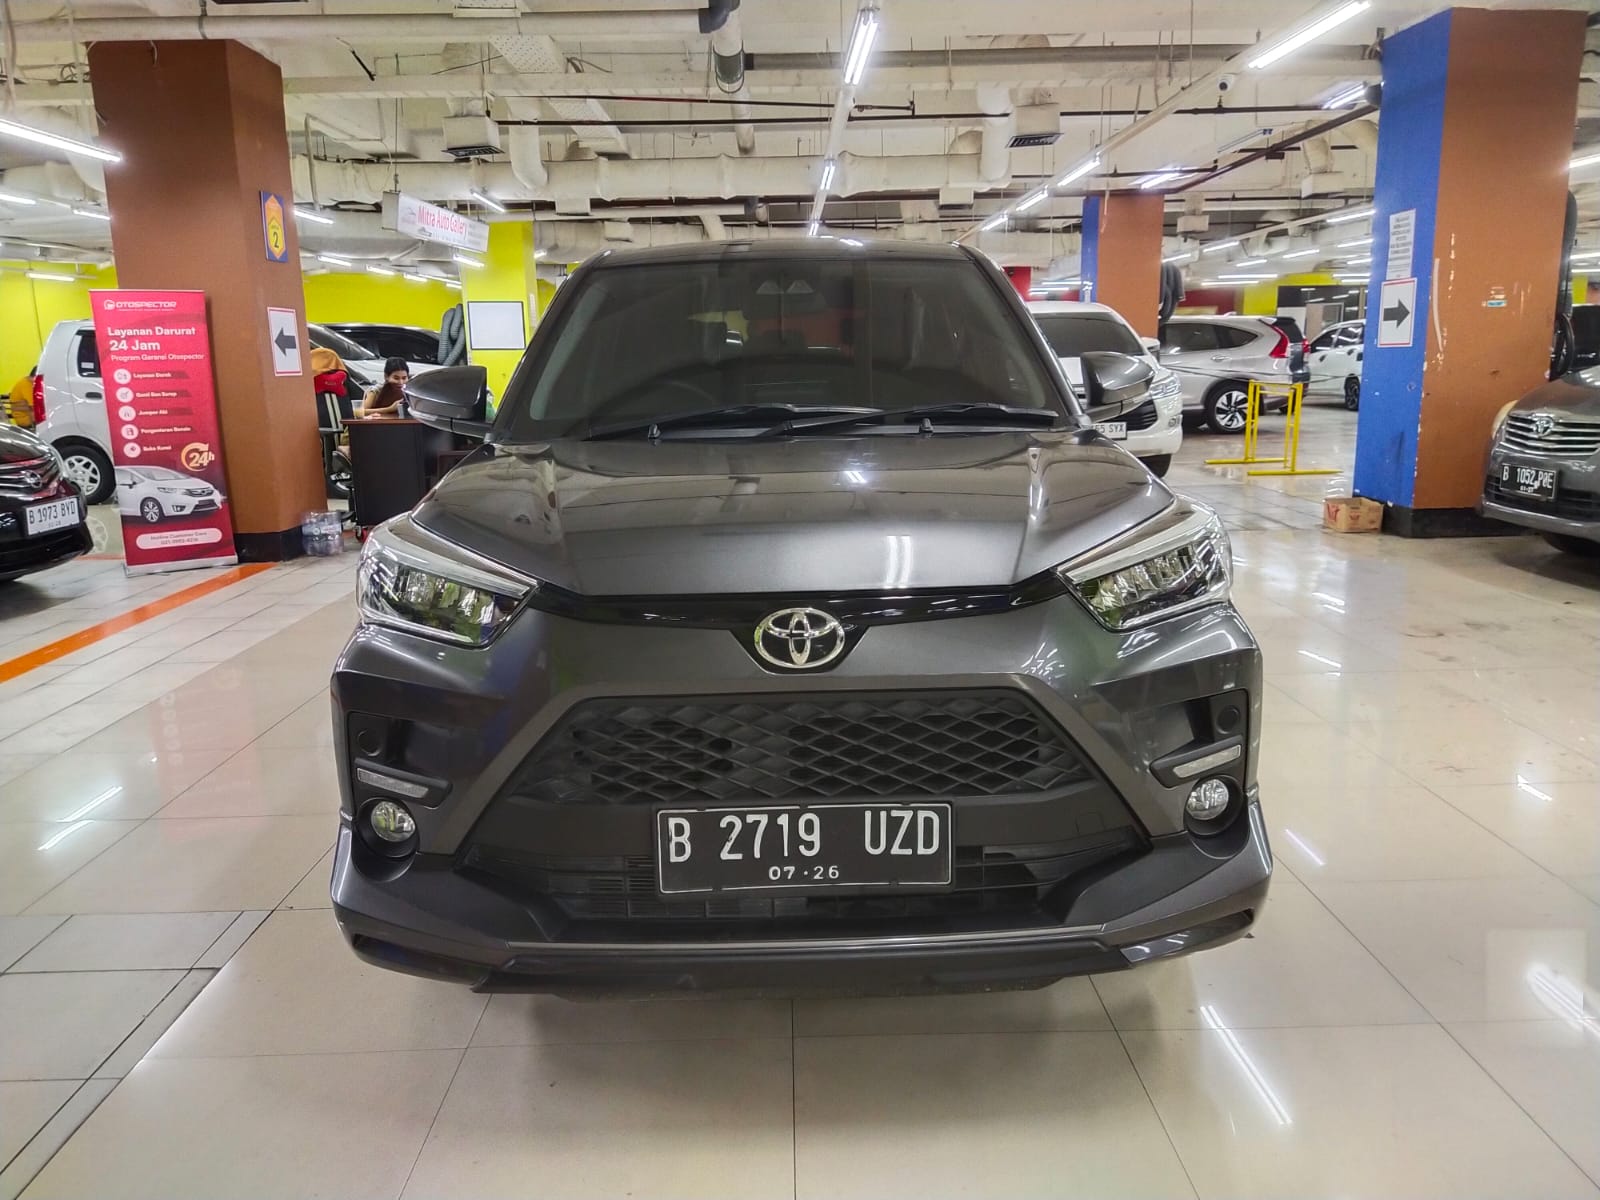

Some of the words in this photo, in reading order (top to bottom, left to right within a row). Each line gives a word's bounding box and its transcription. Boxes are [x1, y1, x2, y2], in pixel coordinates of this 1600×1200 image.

[417, 205, 436, 228] Mitra
[437, 211, 450, 232] Auto
[450, 214, 467, 239] Gallery
[273, 231, 280, 249] 2
[115, 301, 177, 309] OTOSPECTOR
[107, 327, 153, 338] Layanan
[155, 326, 196, 336] Darurat
[109, 340, 128, 351] 24
[131, 340, 161, 351] Jam
[111, 354, 140, 362] Program
[168, 353, 204, 361] Otospector
[1503, 466, 1509, 481] B
[1517, 468, 1536, 485] 1052
[29, 510, 35, 524] B
[37, 504, 58, 523] 1973
[668, 816, 692, 863] B
[719, 812, 821, 860] 2719
[864, 809, 940, 855] UZD
